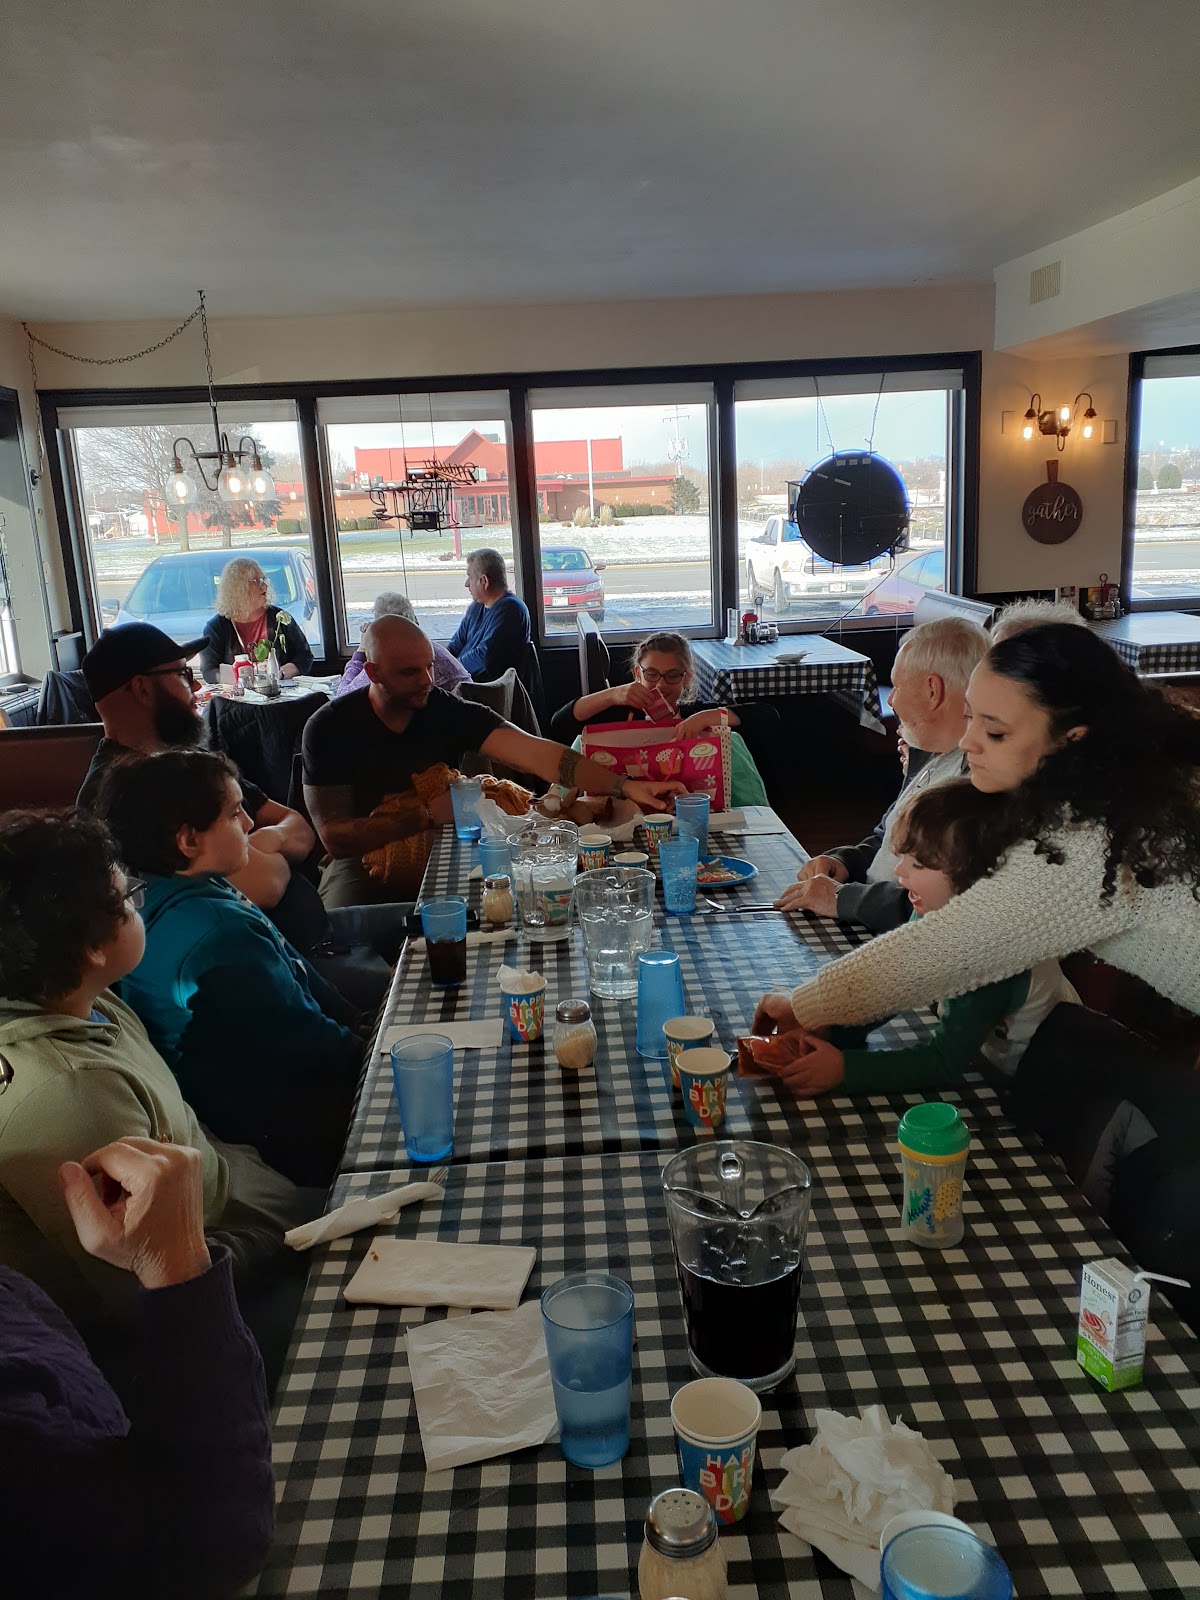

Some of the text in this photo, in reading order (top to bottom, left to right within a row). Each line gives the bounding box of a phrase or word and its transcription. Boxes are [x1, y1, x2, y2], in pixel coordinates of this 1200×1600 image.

[1027, 495, 1078, 525] gather
[645, 824, 670, 832] HAPPY
[581, 849, 606, 857] HAPPY
[511, 996, 542, 1007] HAPP
[509, 1006, 543, 1019] BIRT
[517, 1016, 543, 1033] DAY
[1083, 1271, 1116, 1303] Honest
[706, 1447, 751, 1468] HAP
[700, 1467, 746, 1492] BIR
[715, 1488, 749, 1512] DA
